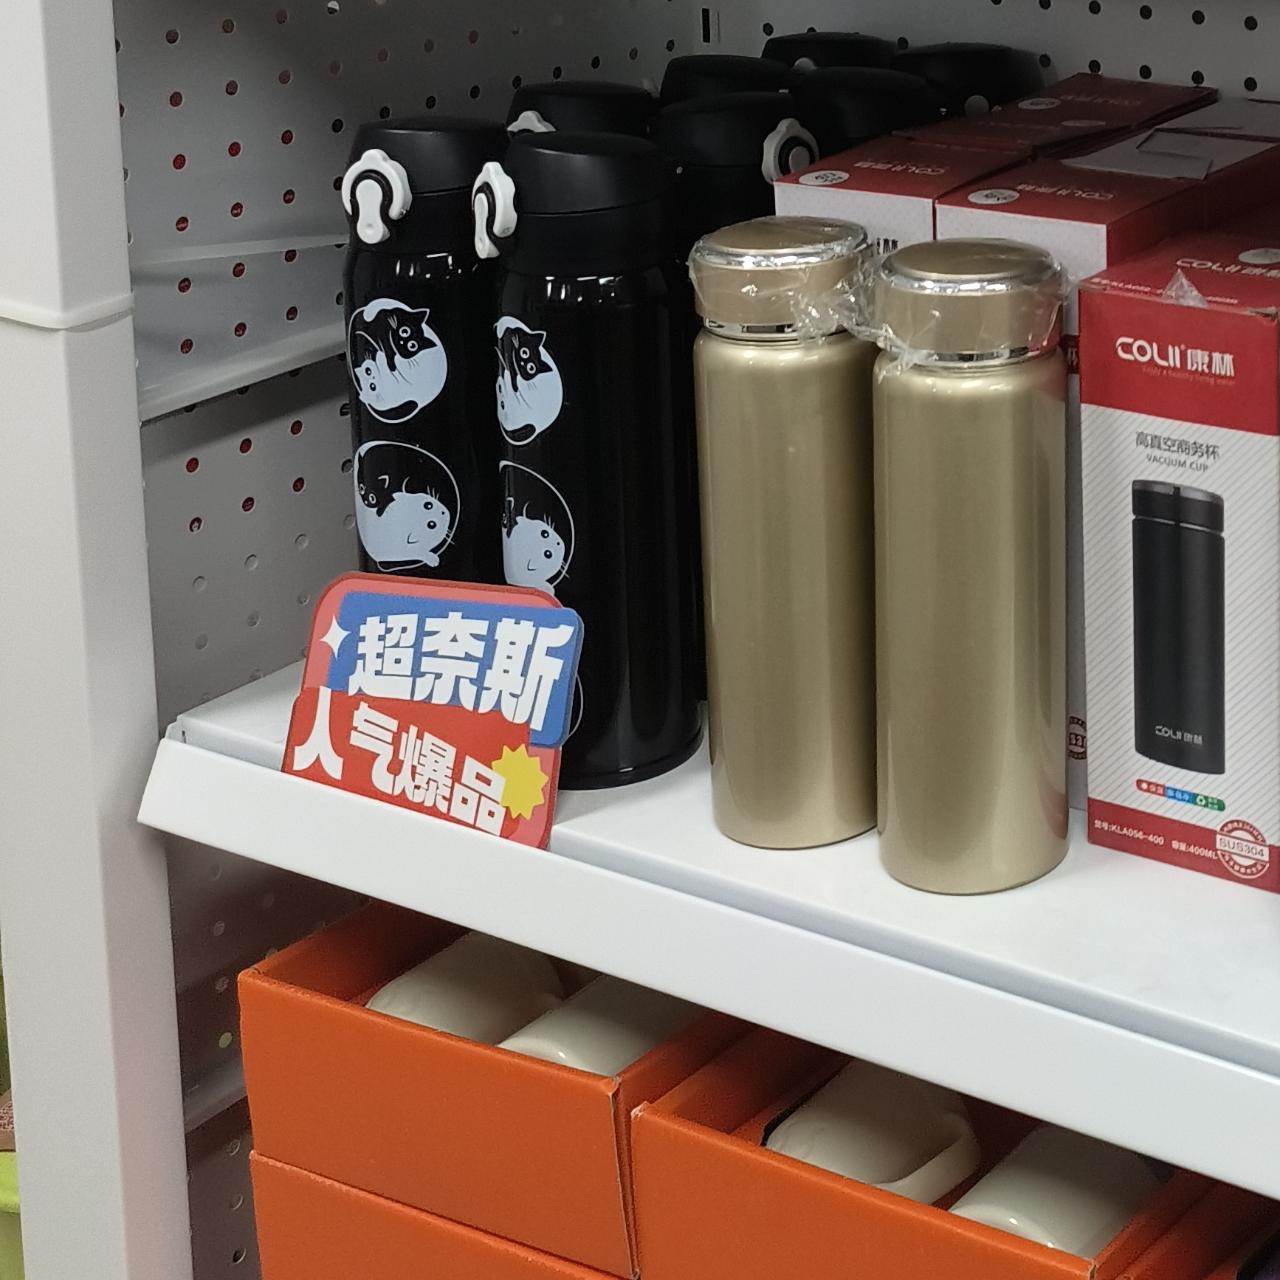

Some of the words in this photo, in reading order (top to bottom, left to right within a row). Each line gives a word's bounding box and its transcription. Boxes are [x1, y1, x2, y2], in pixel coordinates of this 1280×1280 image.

[1115, 335, 1181, 368] COLII
[1186, 348, 1236, 378] 康林
[1135, 431, 1220, 461] 高真空商务杯
[1146, 453, 1187, 469] VACUUM
[1189, 461, 1209, 473] CUP
[347, 610, 575, 733] 超奈斯
[292, 685, 508, 838] 人气爆品
[1218, 837, 1265, 859] SUS304
